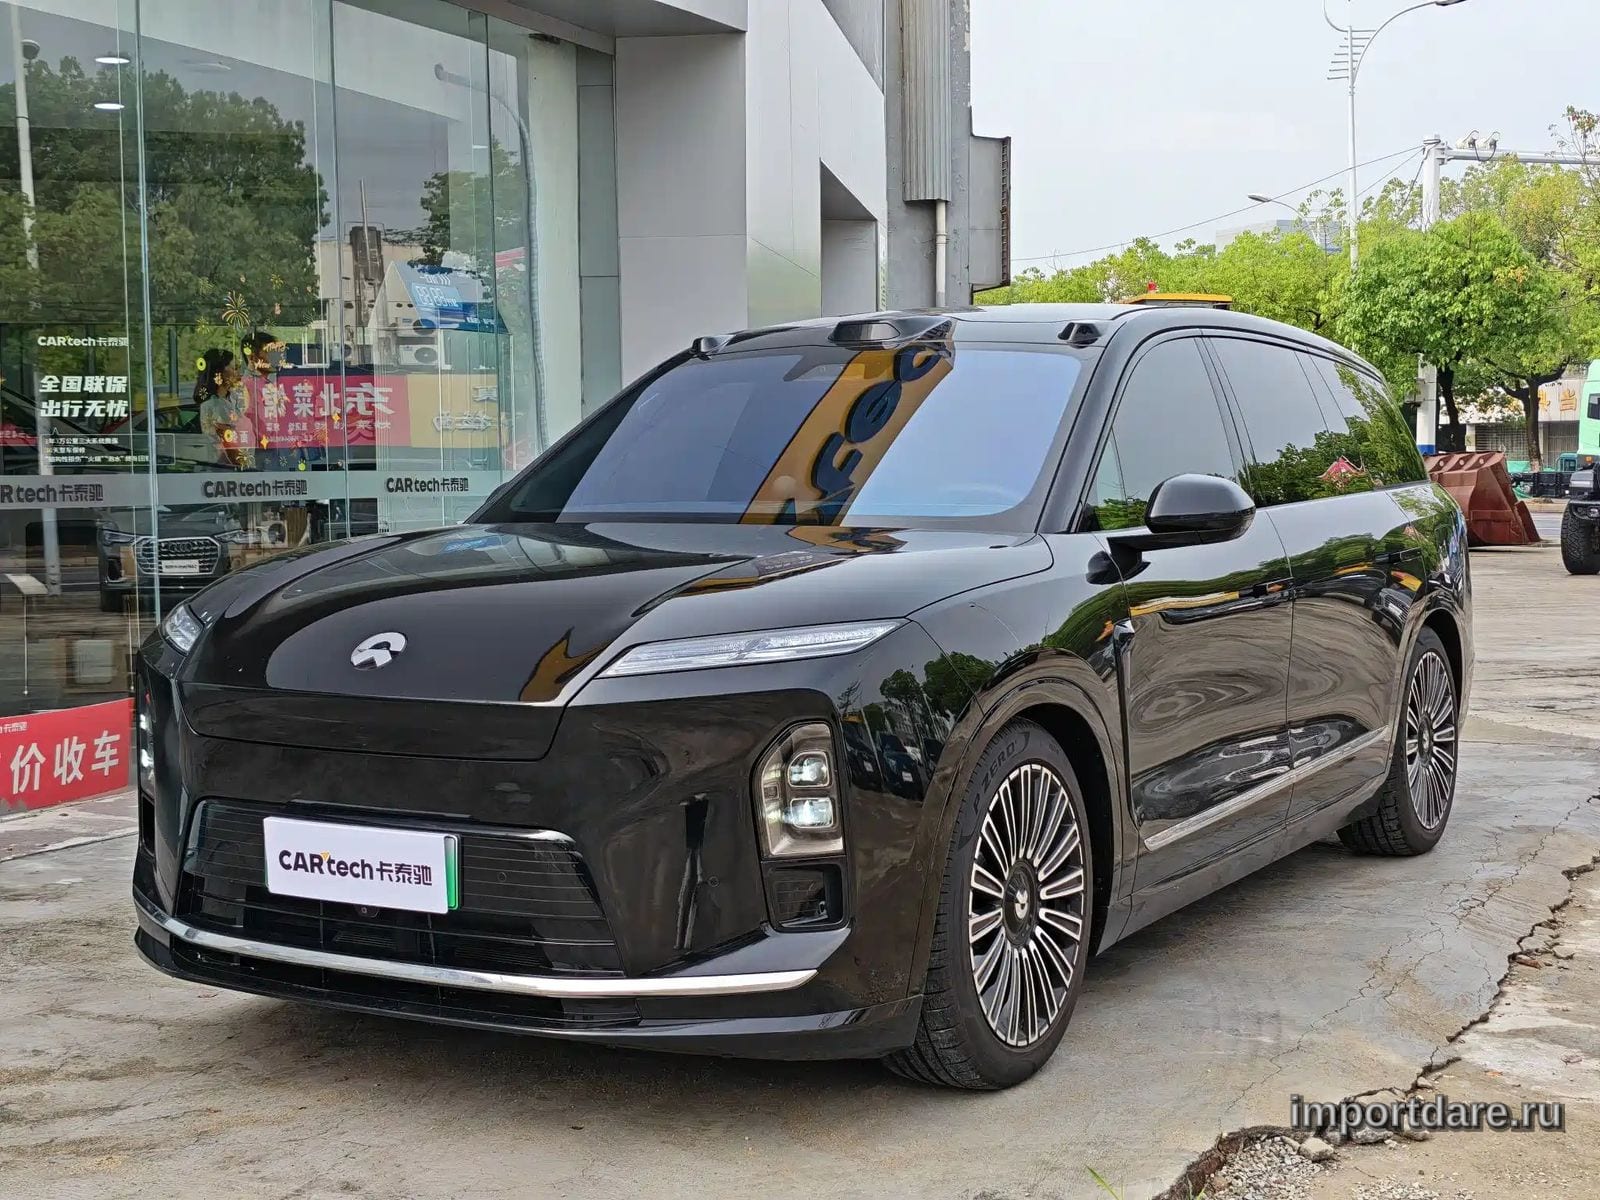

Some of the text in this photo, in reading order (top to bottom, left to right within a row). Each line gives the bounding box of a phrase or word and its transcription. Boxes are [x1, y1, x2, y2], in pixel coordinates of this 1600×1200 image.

[39, 375, 128, 393] 全国联保
[40, 400, 128, 417] 出行无忧
[59, 484, 104, 502] 卡泰驰
[203, 480, 308, 498] CARtech 卡泰驰
[386, 477, 469, 493] CARtech 卡泰驰
[278, 849, 433, 886] CARtech 卡泰驰
